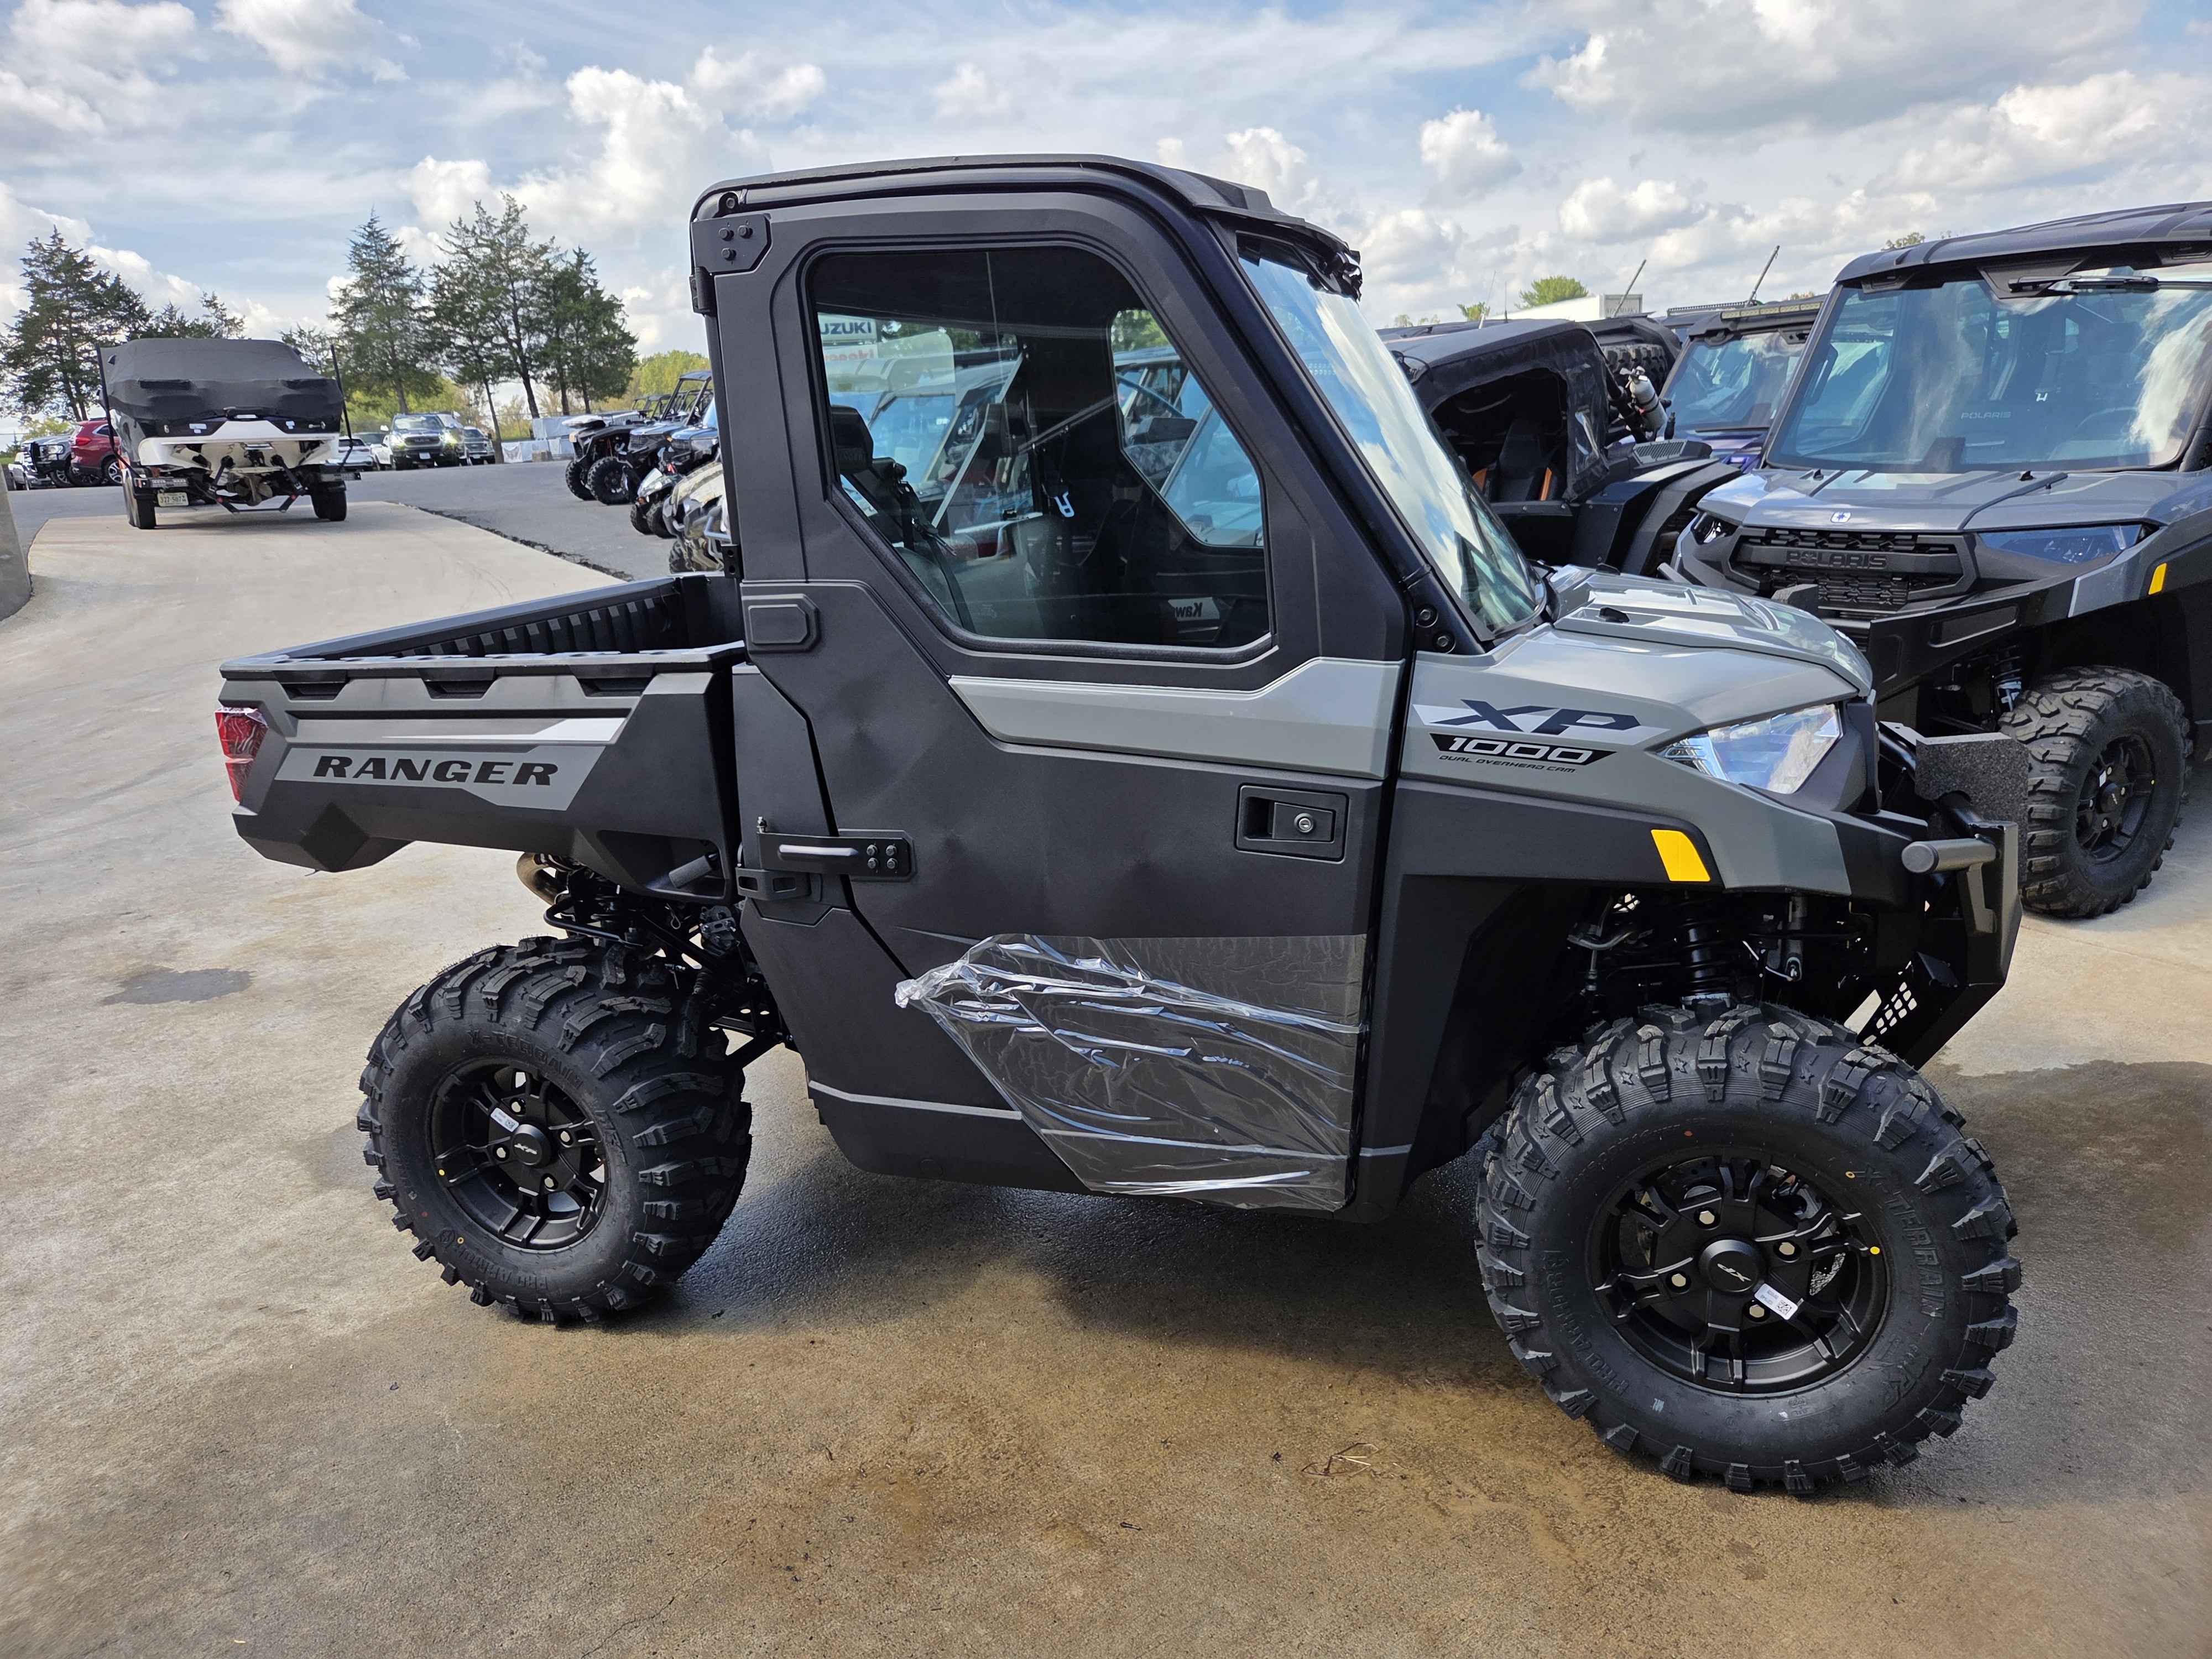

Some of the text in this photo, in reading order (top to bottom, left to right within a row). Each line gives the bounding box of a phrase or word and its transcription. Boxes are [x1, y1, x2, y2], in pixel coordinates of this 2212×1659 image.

[1960, 411, 2011, 419] POLARIS
[1786, 550, 1887, 570] POLARIS
[1429, 699, 1641, 735] XP
[1448, 737, 1593, 763] 1000
[313, 755, 558, 786] RANGER
[1438, 755, 1472, 763] DUAL
[1475, 758, 1545, 770] OVERHEAD
[1717, 1263, 1751, 1282] XP
